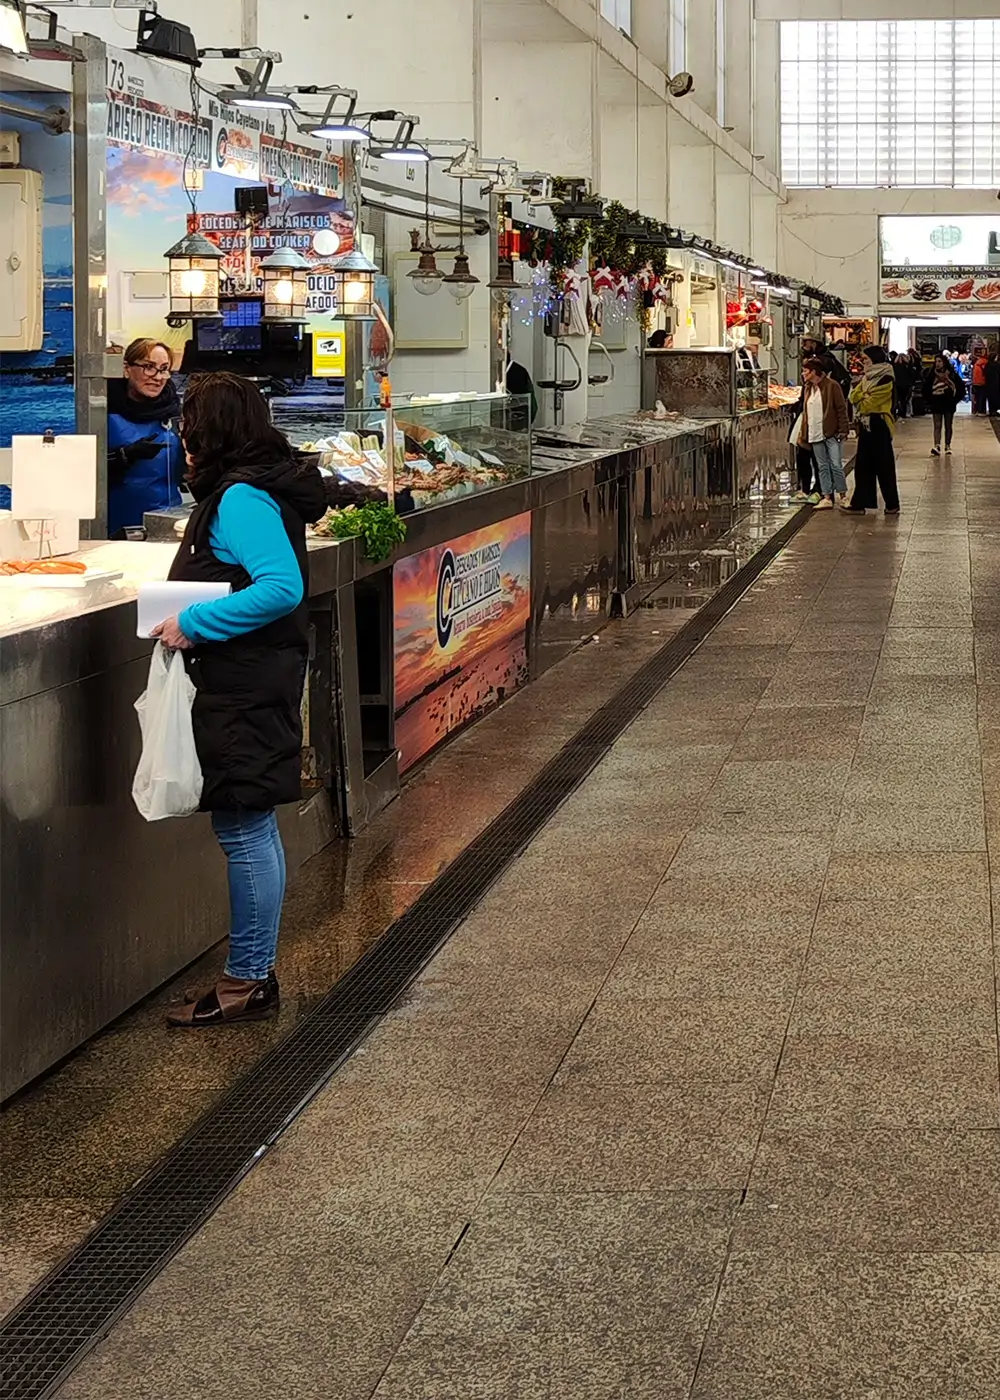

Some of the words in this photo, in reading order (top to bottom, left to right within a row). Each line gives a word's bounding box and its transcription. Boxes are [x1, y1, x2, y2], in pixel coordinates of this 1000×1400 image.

[106, 102, 143, 144] ARISCO
[177, 121, 210, 161] COCDO
[200, 215, 248, 230] COCEDER
[276, 215, 331, 229] MARISCOS
[219, 235, 267, 248] SEAFOD
